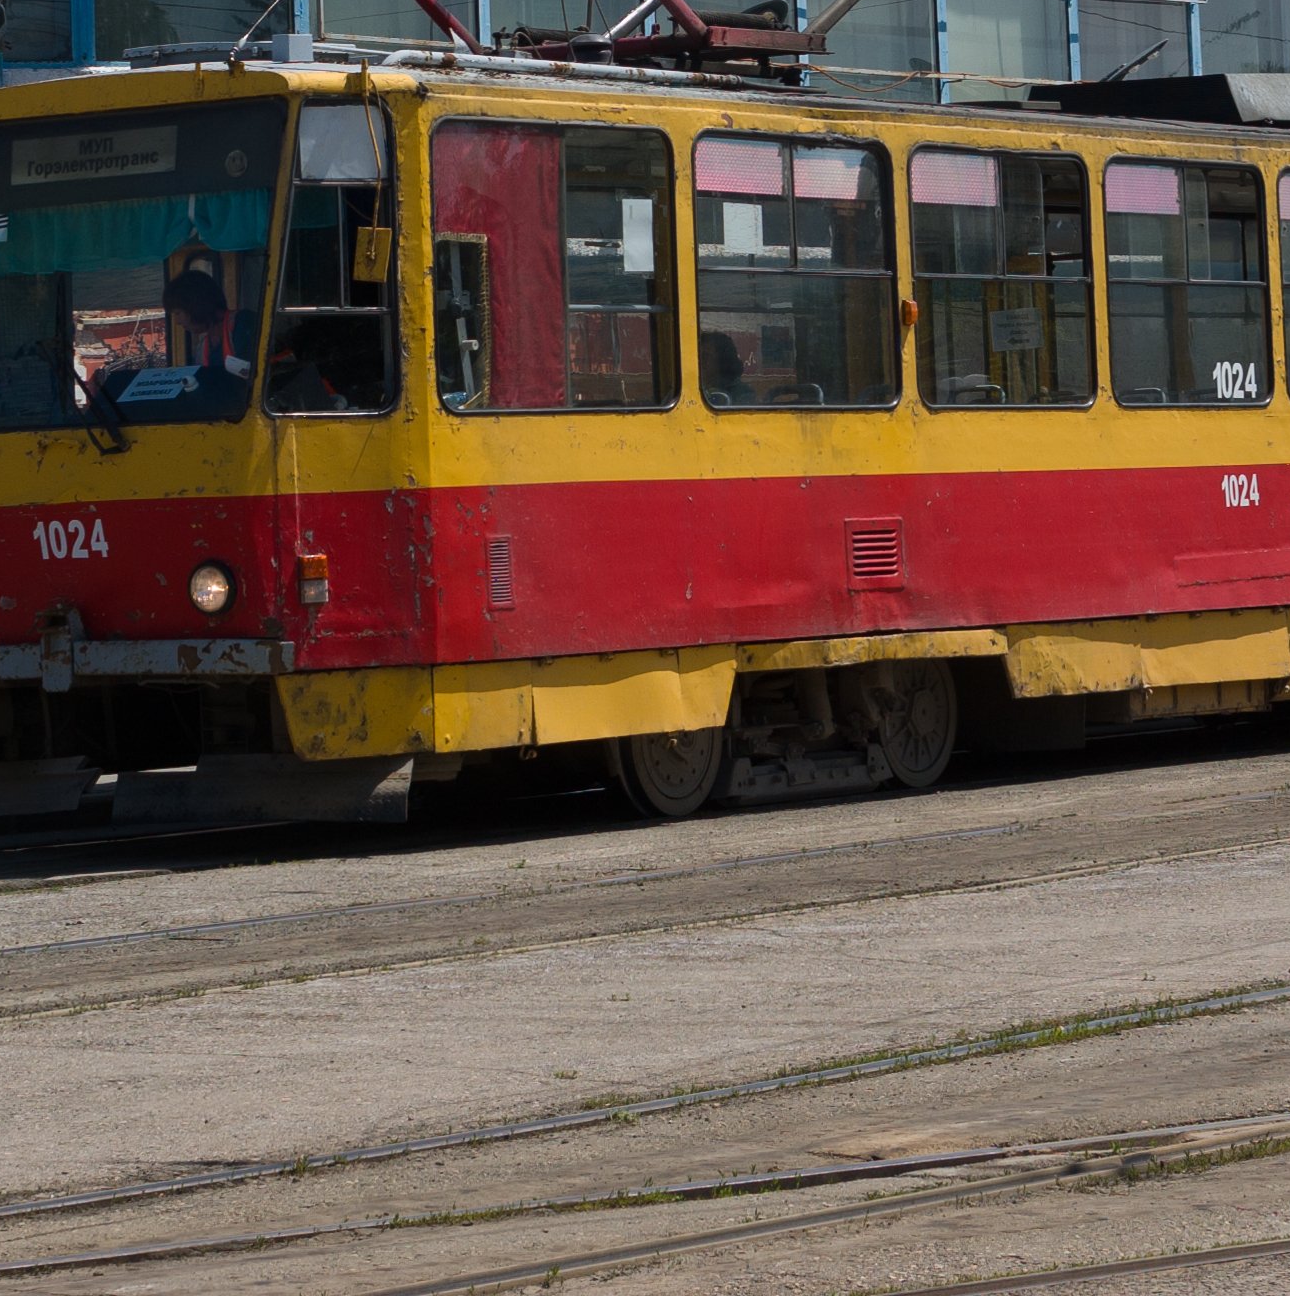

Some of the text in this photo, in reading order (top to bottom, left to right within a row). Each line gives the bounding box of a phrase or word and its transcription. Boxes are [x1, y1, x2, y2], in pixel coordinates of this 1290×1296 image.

[27, 150, 159, 178] Горэлектротранс
[78, 137, 114, 156] МУП
[1212, 361, 1258, 399] 1024
[1222, 473, 1260, 508] 1024
[33, 519, 110, 560] 1024
